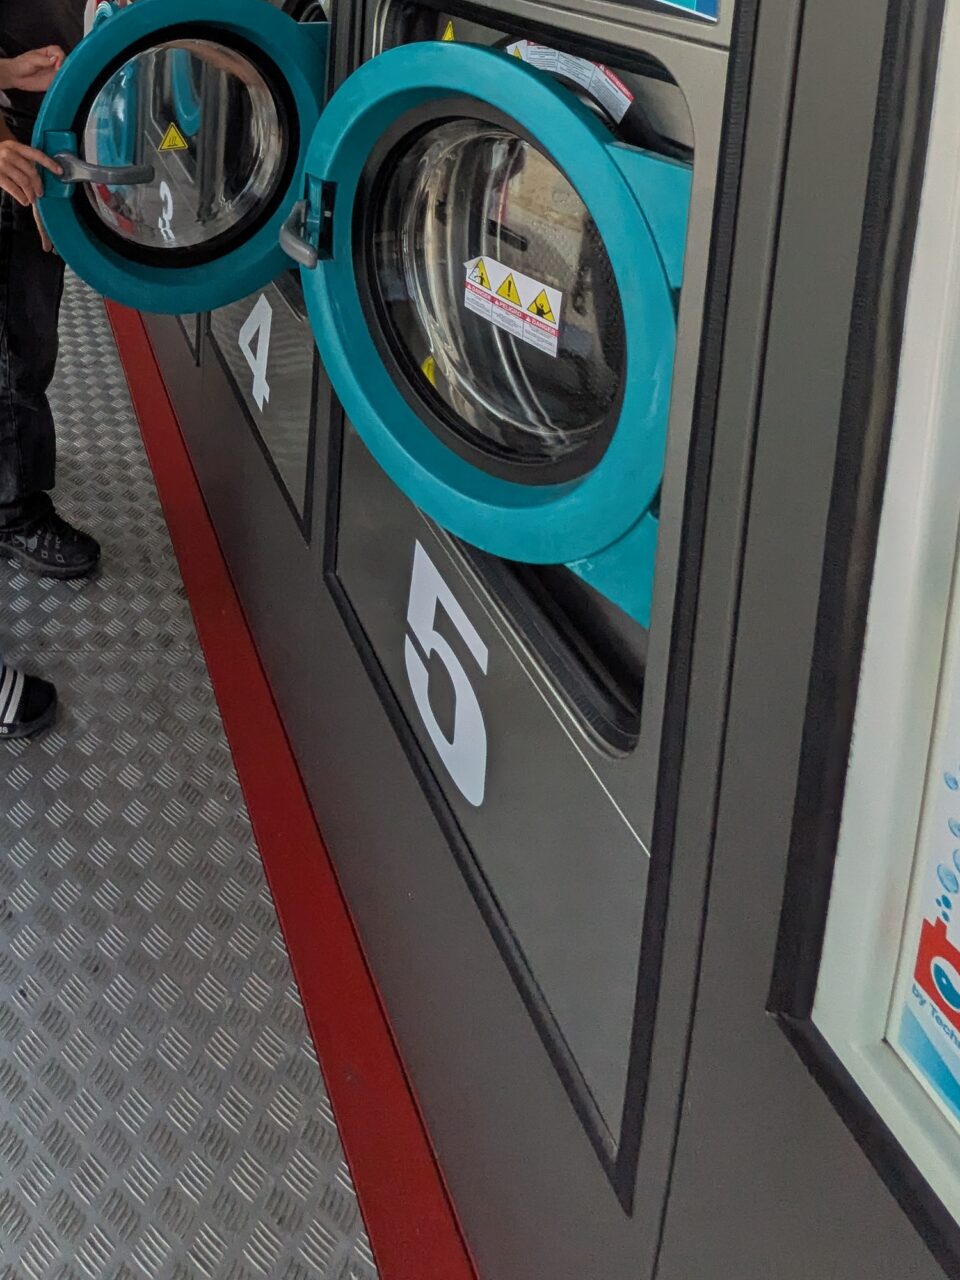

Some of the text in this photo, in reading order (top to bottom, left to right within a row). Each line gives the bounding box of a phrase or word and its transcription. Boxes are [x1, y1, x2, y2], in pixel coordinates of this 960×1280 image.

[238, 292, 273, 413] 4
[405, 538, 488, 807] 5
[912, 984, 927, 1007] by
